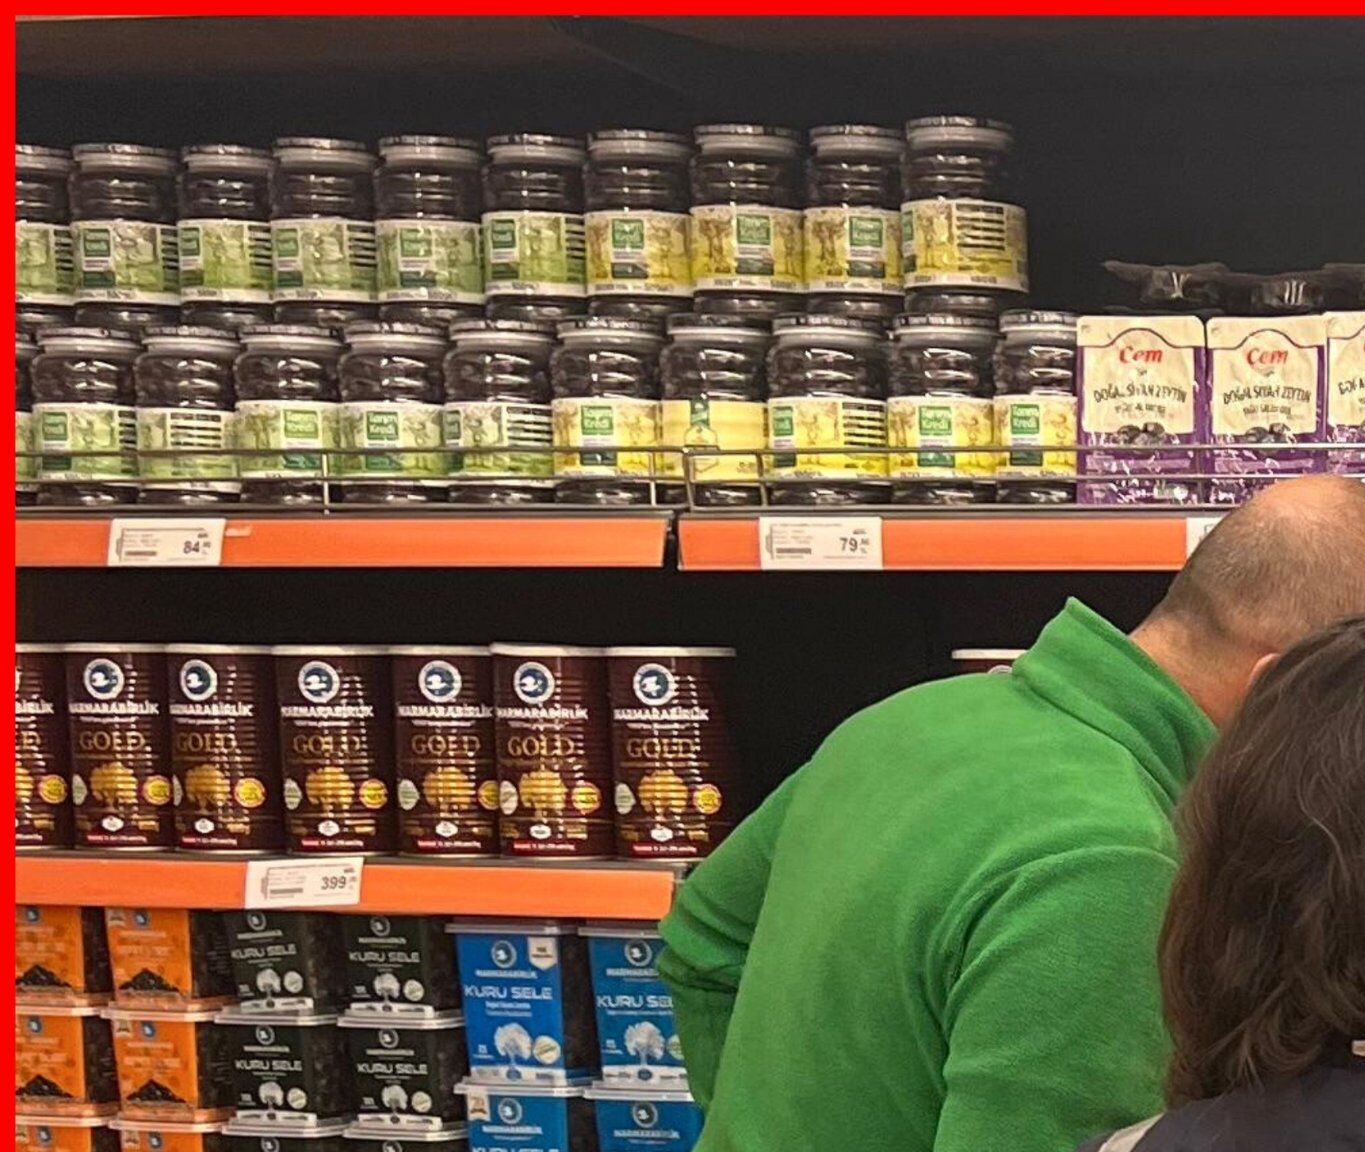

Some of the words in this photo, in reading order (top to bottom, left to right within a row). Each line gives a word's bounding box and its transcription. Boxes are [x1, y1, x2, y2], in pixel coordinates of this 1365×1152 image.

[464, 985, 508, 999] KURU
[511, 986, 552, 1000] SELE
[597, 995, 644, 1008] KURU
[647, 995, 674, 1008] SEL
